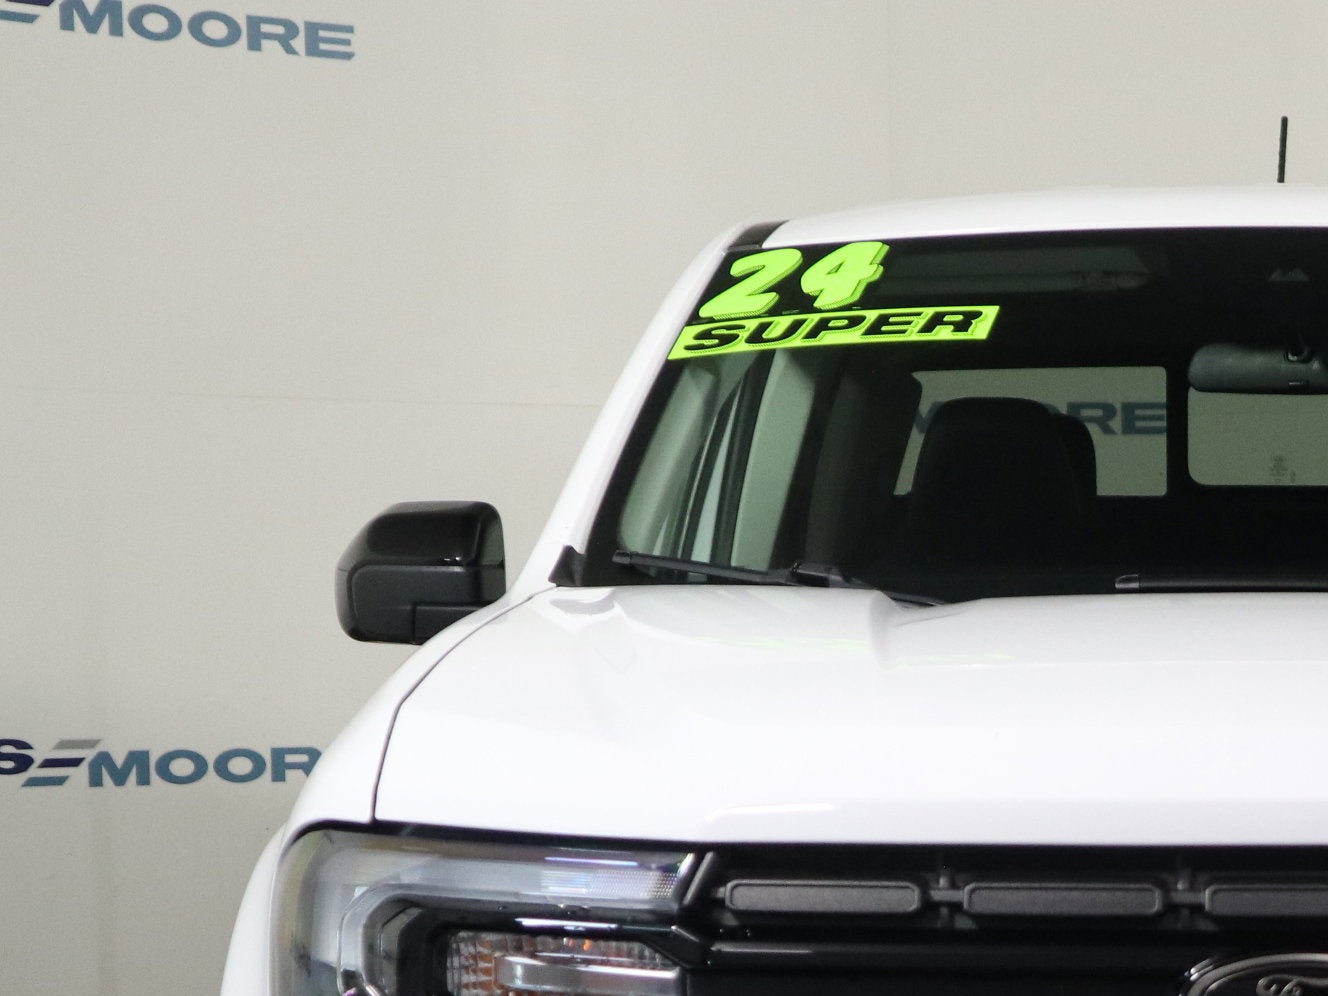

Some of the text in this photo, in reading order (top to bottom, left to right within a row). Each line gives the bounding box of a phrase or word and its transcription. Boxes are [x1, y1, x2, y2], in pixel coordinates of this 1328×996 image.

[59, 0, 355, 60] MOORE
[699, 241, 890, 321] 24
[683, 310, 986, 353] SUPER
